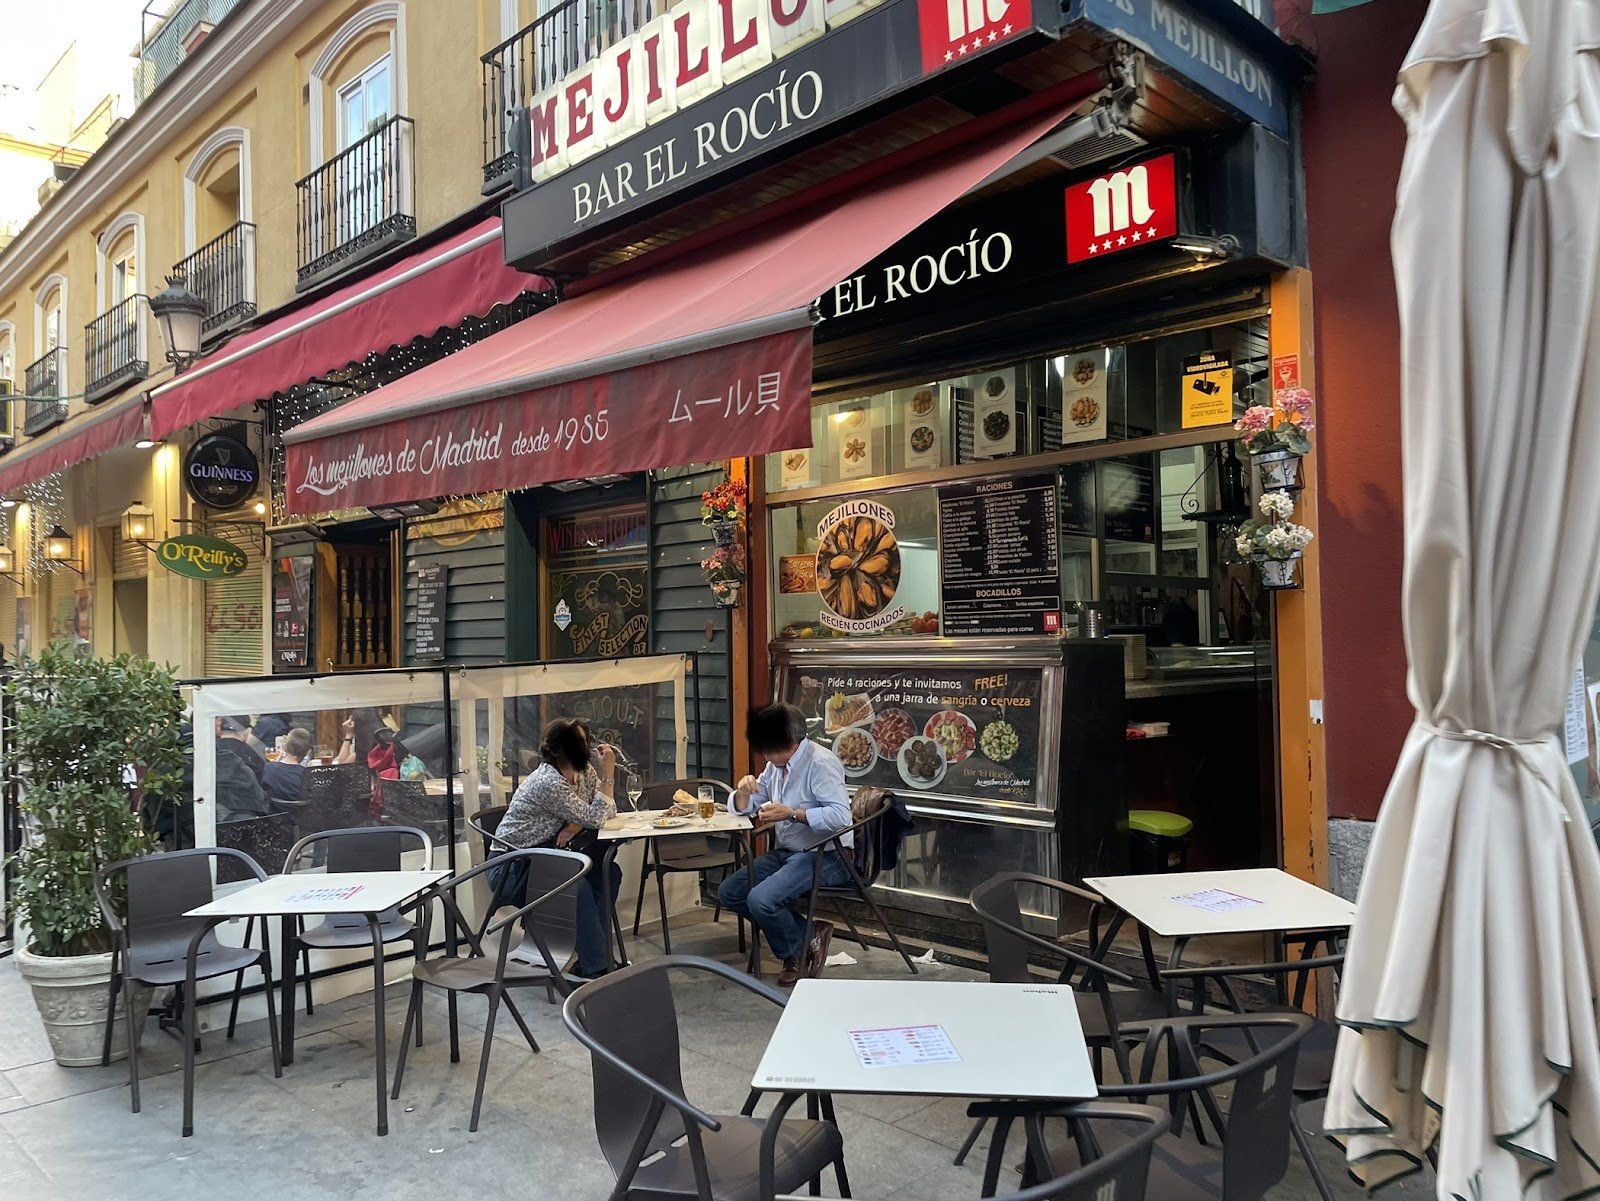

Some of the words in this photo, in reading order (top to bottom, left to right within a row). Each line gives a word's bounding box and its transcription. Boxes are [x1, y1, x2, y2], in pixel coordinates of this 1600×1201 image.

[1150, 3, 1273, 107] MEJILLON
[531, 0, 834, 168] MEJILL
[572, 161, 638, 224] BAR
[643, 138, 688, 192] EL
[694, 69, 823, 168] ROCÍO
[833, 273, 876, 318] EL
[883, 228, 1013, 303] ROCÍO
[668, 371, 781, 423] ムール貝
[190, 463, 253, 482] GUINNESS
[296, 456, 338, 495] Los
[327, 443, 392, 489] mejillones
[396, 439, 416, 473] de
[419, 422, 503, 475] Madrid
[511, 426, 551, 456] desde
[976, 481, 1013, 493] RACIONES
[819, 502, 894, 535] MEJILLONES
[162, 542, 244, 574] O'Reilly's
[976, 587, 1022, 598] BOCADILLOS
[576, 614, 608, 653] FINEST
[821, 613, 850, 630] RECIÉN
[852, 606, 904, 631] COCINADOS
[600, 617, 647, 654] SELECTION
[635, 644, 644, 653] OF
[827, 677, 845, 688] Pide
[846, 678, 853, 687] 4
[855, 678, 892, 688] raciones
[894, 680, 900, 689] y
[902, 678, 912, 688] te
[915, 678, 961, 689] invitamos
[975, 674, 1008, 691] FREE!
[875, 694, 881, 702] a
[884, 693, 900, 702] una
[901, 692, 923, 705] jarra
[926, 692, 938, 704] de
[941, 694, 977, 707] sangría
[981, 697, 988, 705] o
[991, 697, 1031, 706] cerveza
